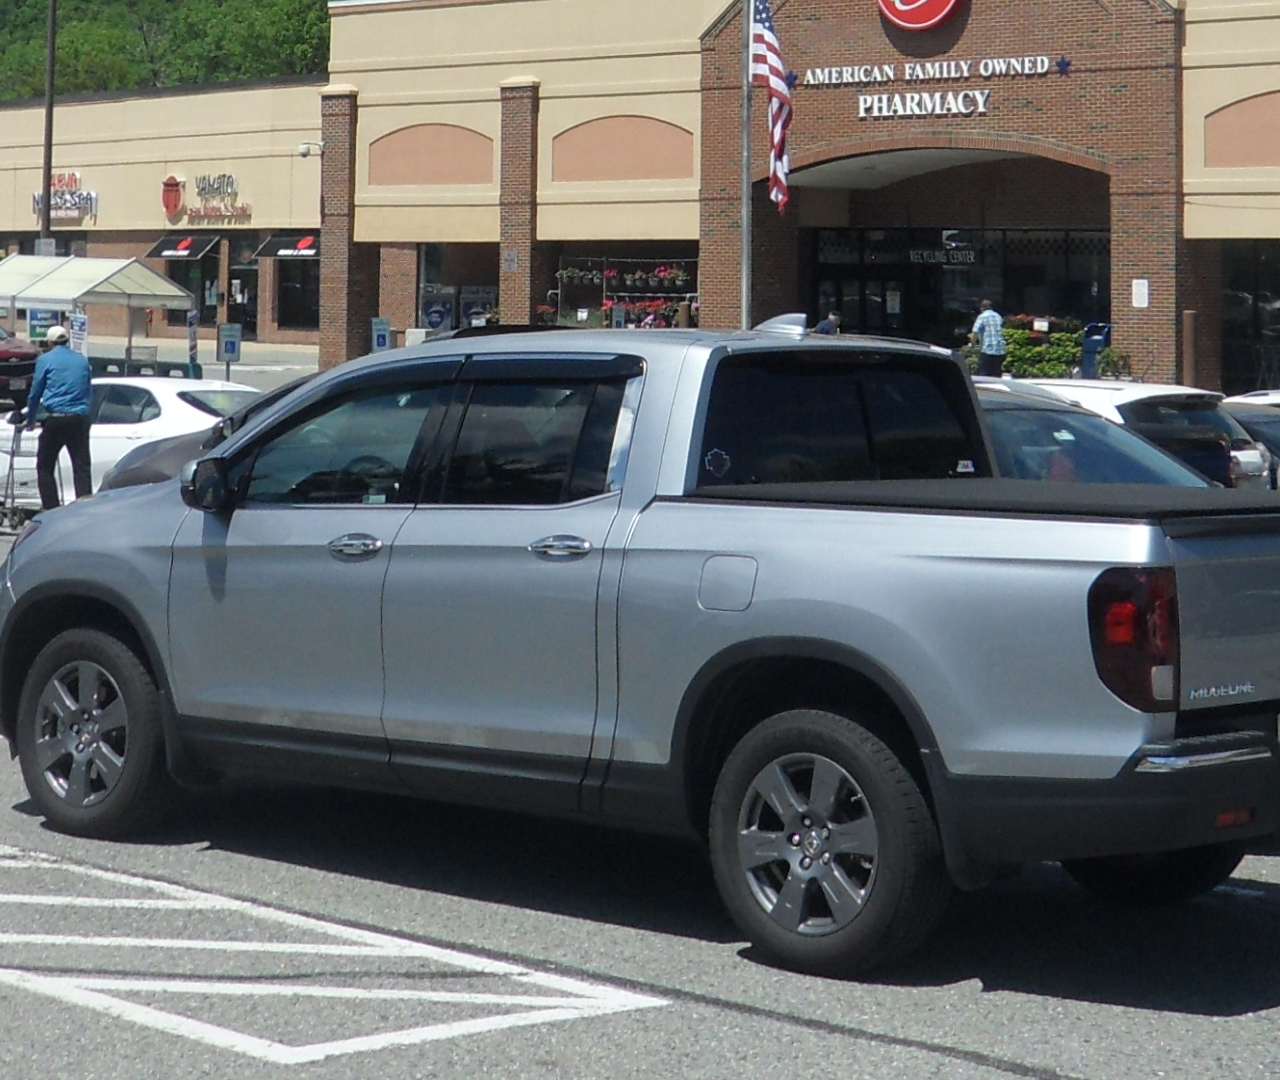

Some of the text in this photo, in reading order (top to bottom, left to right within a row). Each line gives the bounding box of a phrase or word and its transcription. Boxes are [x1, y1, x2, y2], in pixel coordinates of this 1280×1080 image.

[803, 55, 1049, 85] AMERICAN FAMILY OWNED
[858, 90, 990, 117] PHARMACY
[949, 250, 975, 263] CENTER
